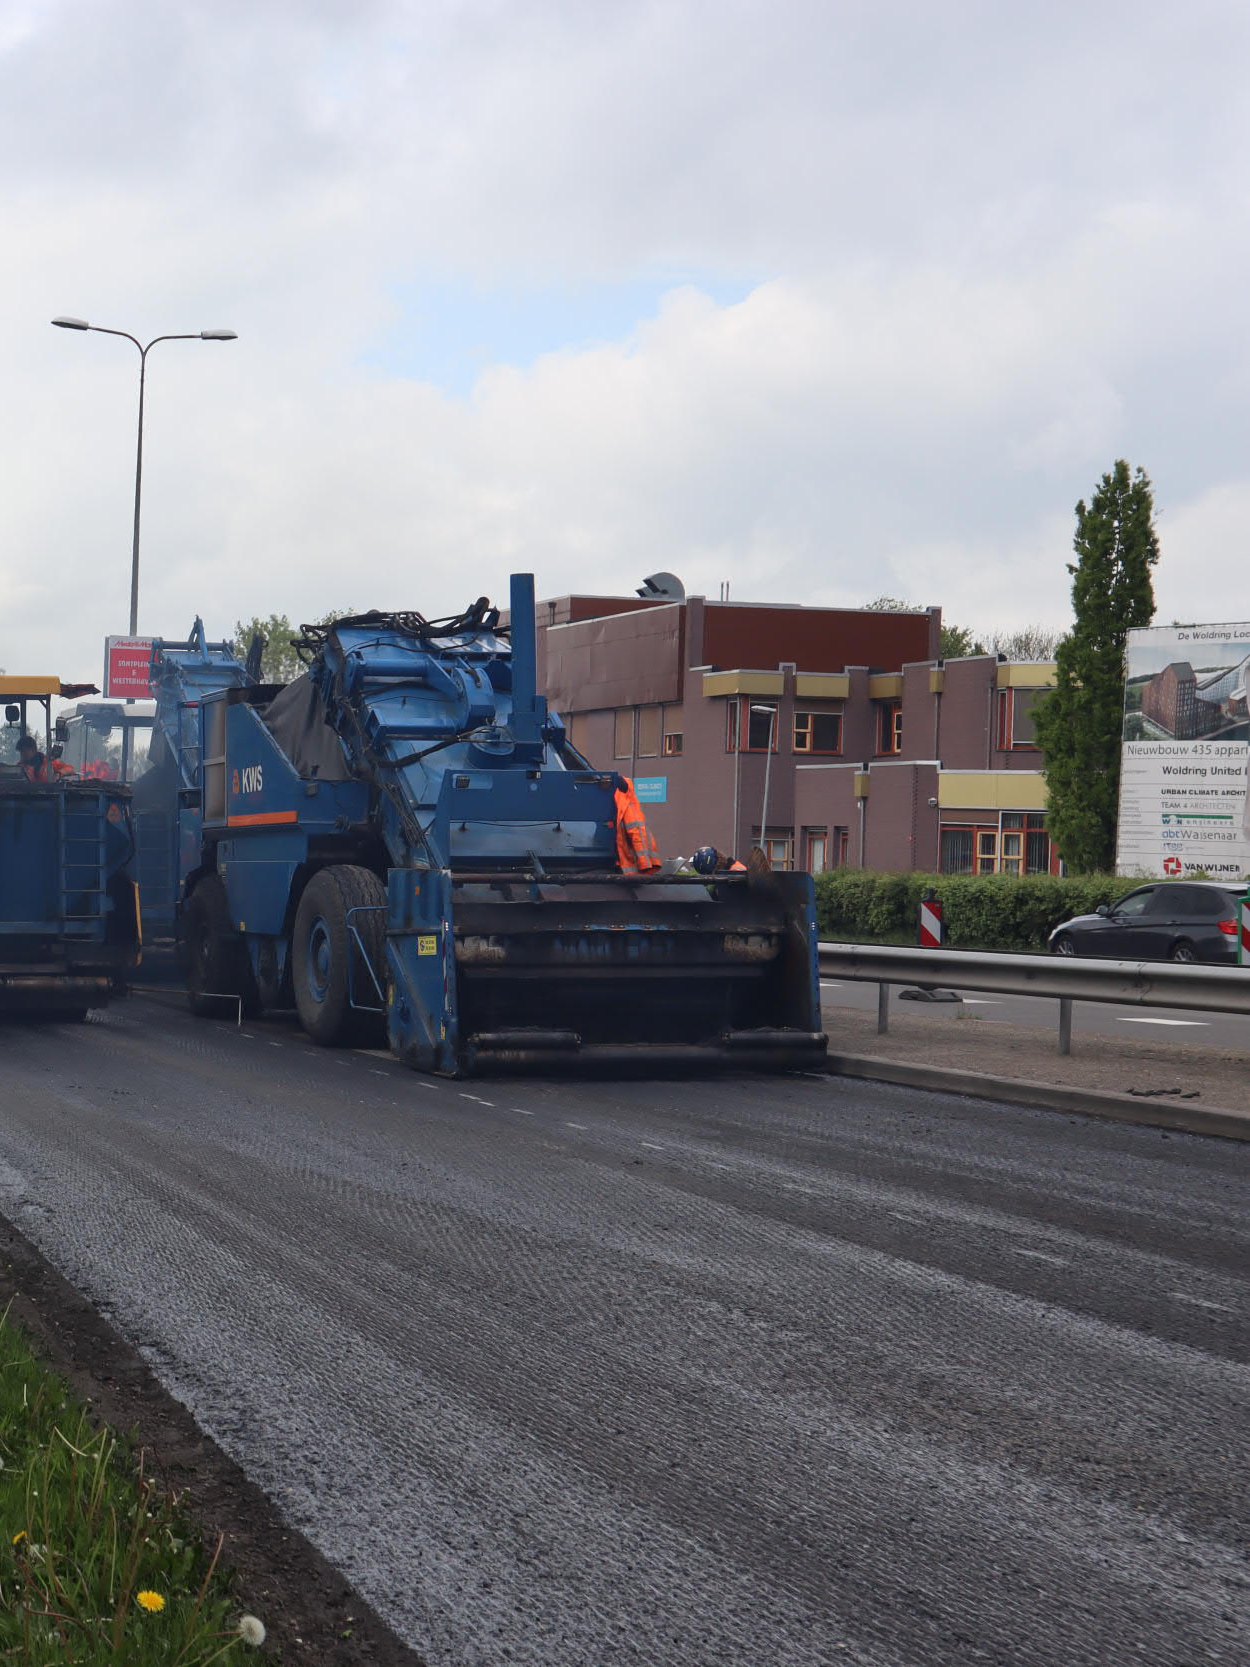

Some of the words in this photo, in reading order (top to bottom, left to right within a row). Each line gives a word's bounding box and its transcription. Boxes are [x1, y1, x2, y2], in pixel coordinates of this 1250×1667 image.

[1178, 632, 1190, 640] De
[1193, 631, 1231, 640] Woldring
[1127, 744, 1189, 755] Nieuwbouw
[1191, 744, 1212, 755] 435
[1162, 766, 1207, 777] Woldring
[1210, 766, 1242, 776] United
[242, 765, 262, 794] KWS
[1161, 801, 1181, 809] TEAM
[1184, 863, 1203, 872] VAN
